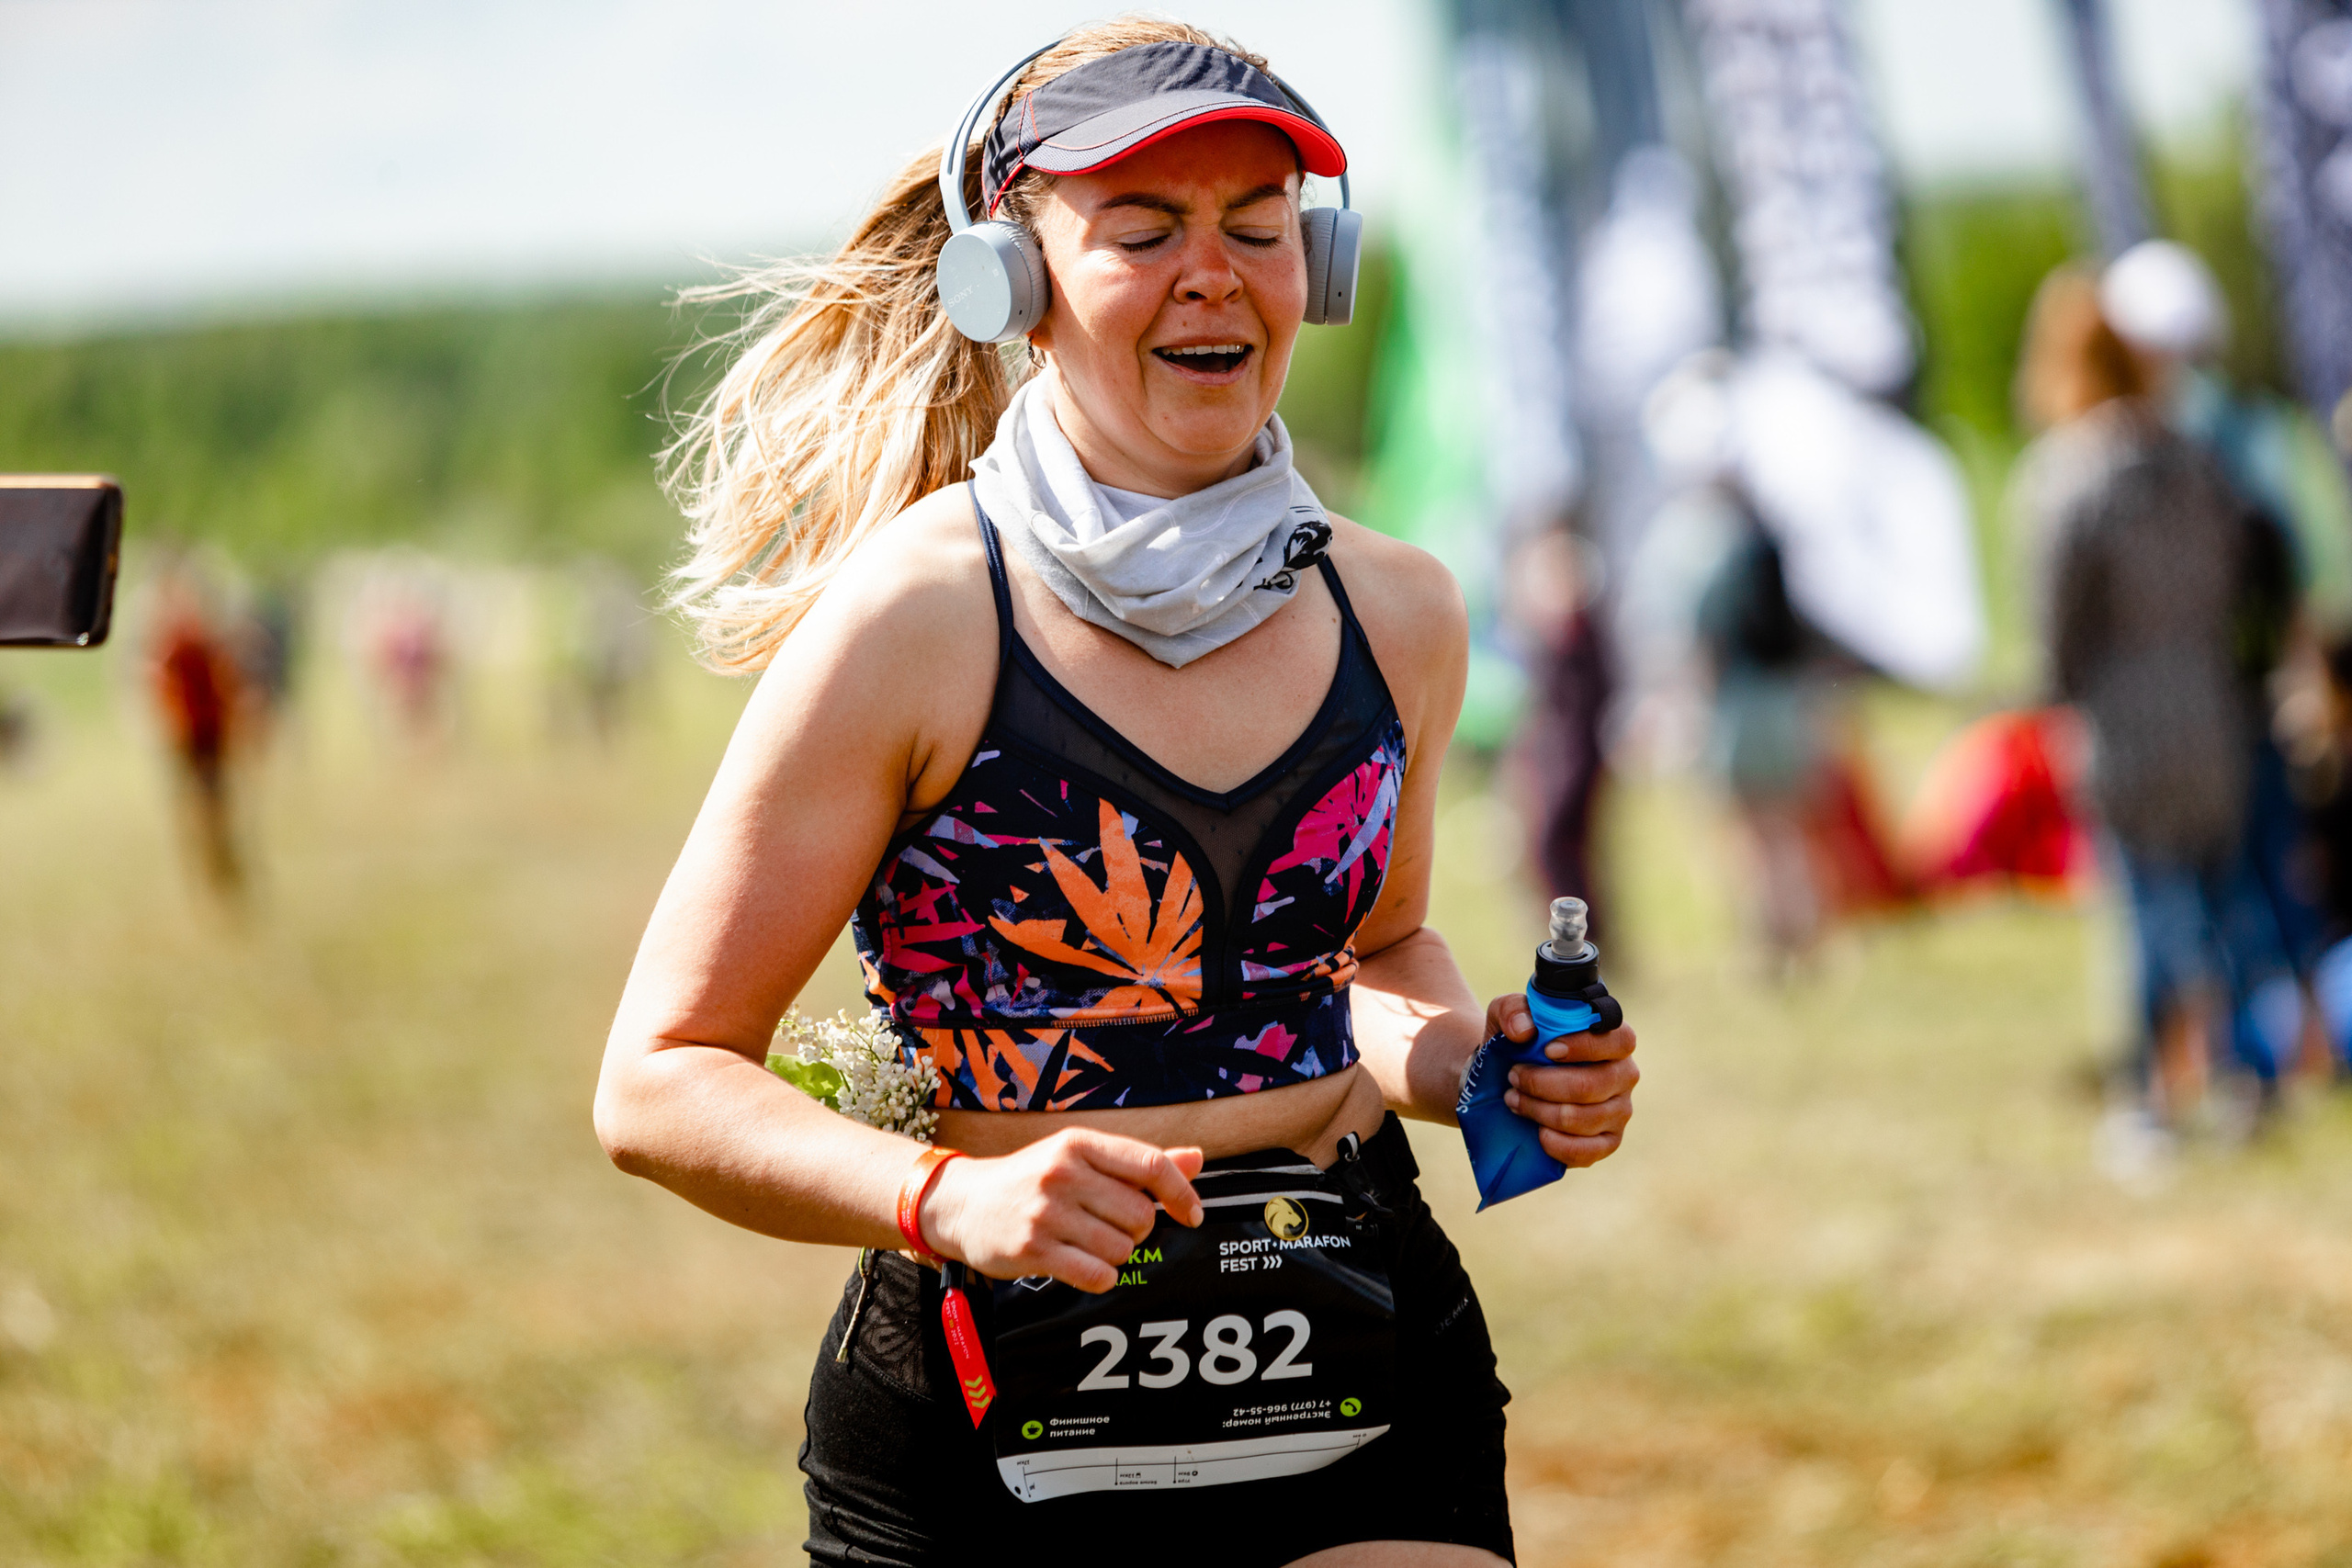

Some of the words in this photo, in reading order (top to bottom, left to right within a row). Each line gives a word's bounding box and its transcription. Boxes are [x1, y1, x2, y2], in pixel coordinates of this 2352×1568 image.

[947, 285, 973, 308] SONY
[1219, 1238, 1272, 1256] SPORT
[1280, 1235, 1351, 1250] MARAFON
[1220, 1257, 1258, 1273] FEST
[1115, 1269, 1148, 1286] AIL
[1077, 1308, 1313, 1392] 2382
[1233, 1404, 1288, 1417] 966-55-42
[1290, 1400, 1317, 1412] (977)
[1318, 1399, 1331, 1408] +7
[1049, 1416, 1110, 1427] Финишное
[1222, 1417, 1261, 1427] номер:
[1264, 1410, 1331, 1426] Экстренный
[1049, 1427, 1096, 1438] питание
